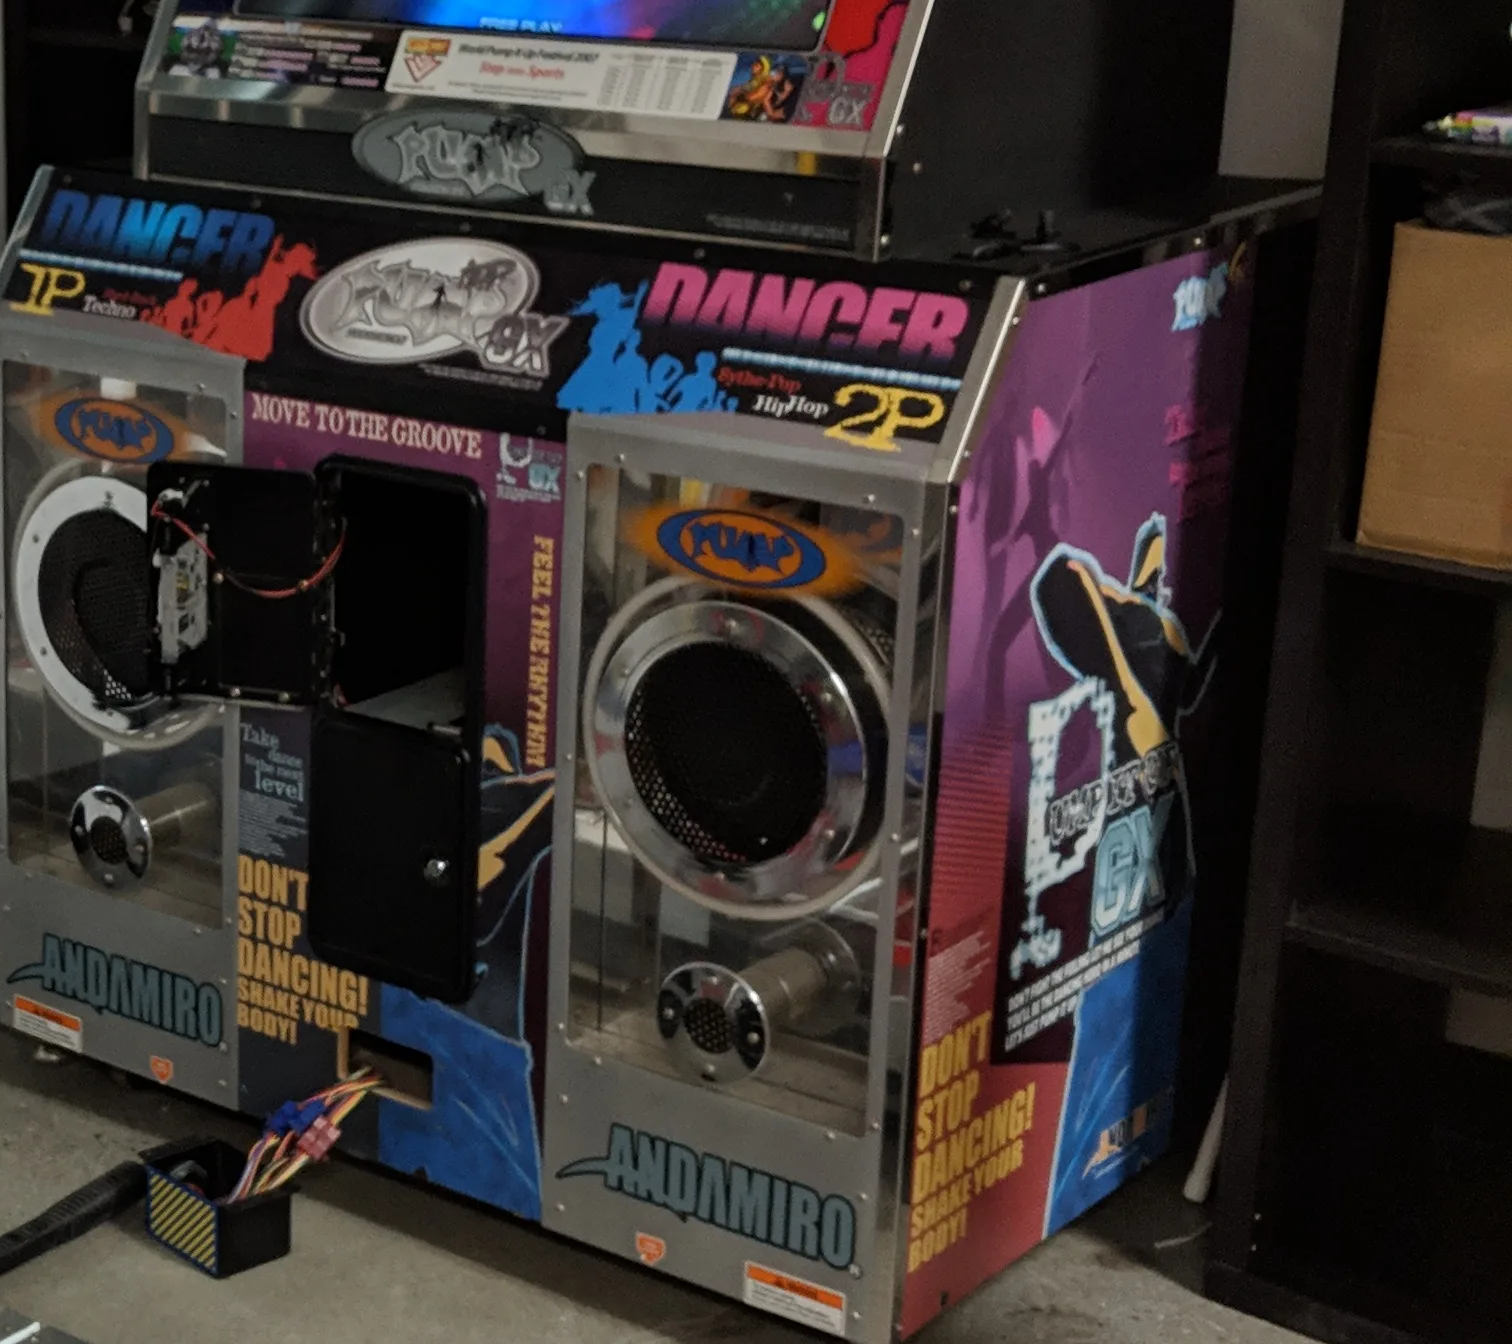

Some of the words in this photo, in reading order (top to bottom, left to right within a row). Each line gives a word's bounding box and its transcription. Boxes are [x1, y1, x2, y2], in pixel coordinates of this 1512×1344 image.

[251, 395, 312, 430] MOVE
[315, 403, 345, 434] TO
[344, 406, 389, 443] THE
[391, 413, 483, 459] GROOVE
[532, 534, 554, 599] FEEL
[239, 722, 280, 749] Take
[255, 768, 304, 802] level
[238, 854, 309, 911] DON'T
[238, 896, 302, 949] STOP
[7, 933, 225, 1049] ANDAMIRO
[238, 939, 369, 1016] DANCING!
[238, 978, 300, 1019] SHAKE
[238, 1004, 298, 1045] BODY!
[920, 1012, 992, 1097] DON'T
[914, 1083, 1036, 1197] DANCING!
[916, 1078, 980, 1150] STOP
[557, 1123, 857, 1270] ANDAMIRO
[910, 1184, 974, 1240] SHAKE
[973, 1143, 1024, 1197] YOUR
[908, 1208, 969, 1274] BODY!
